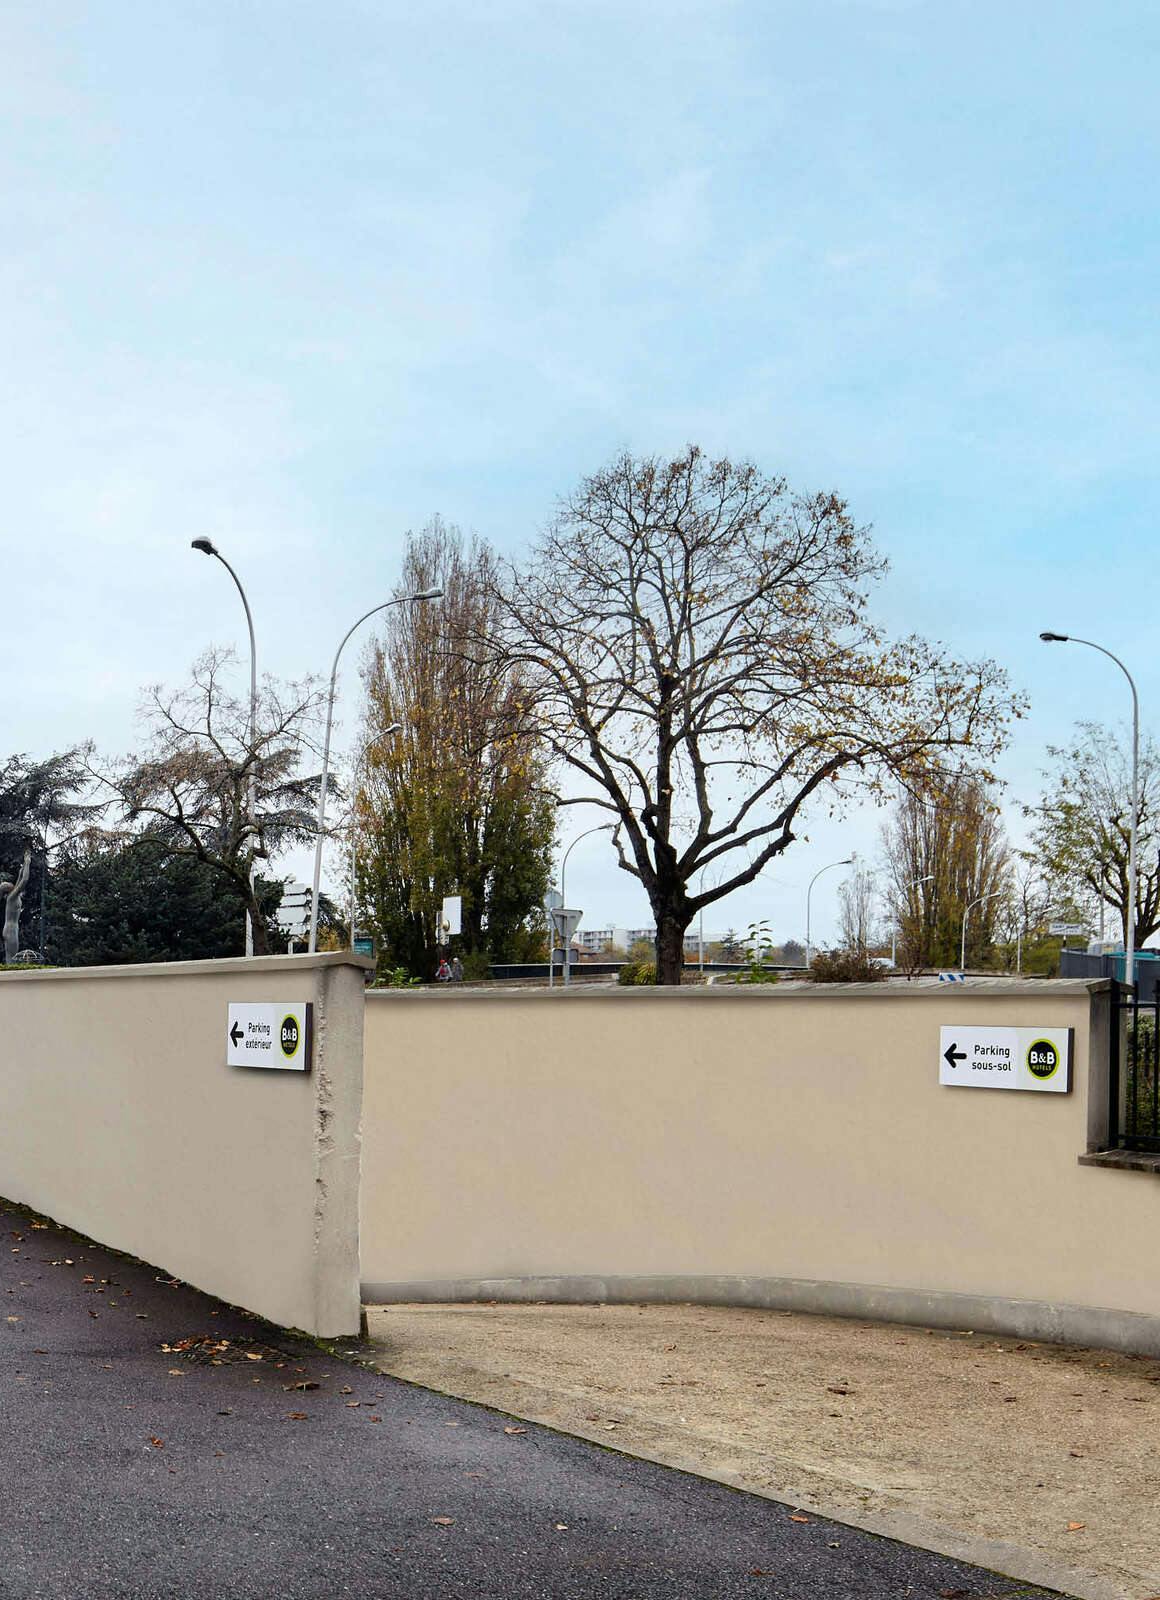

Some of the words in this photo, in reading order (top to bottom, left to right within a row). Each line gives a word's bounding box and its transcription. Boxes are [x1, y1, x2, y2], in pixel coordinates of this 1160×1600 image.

[248, 1022, 270, 1035] Parking
[282, 1028, 297, 1041] B&B
[975, 1045, 1010, 1058] Parking
[1030, 1051, 1055, 1064] B&B
[972, 1061, 1011, 1071] sous-sol
